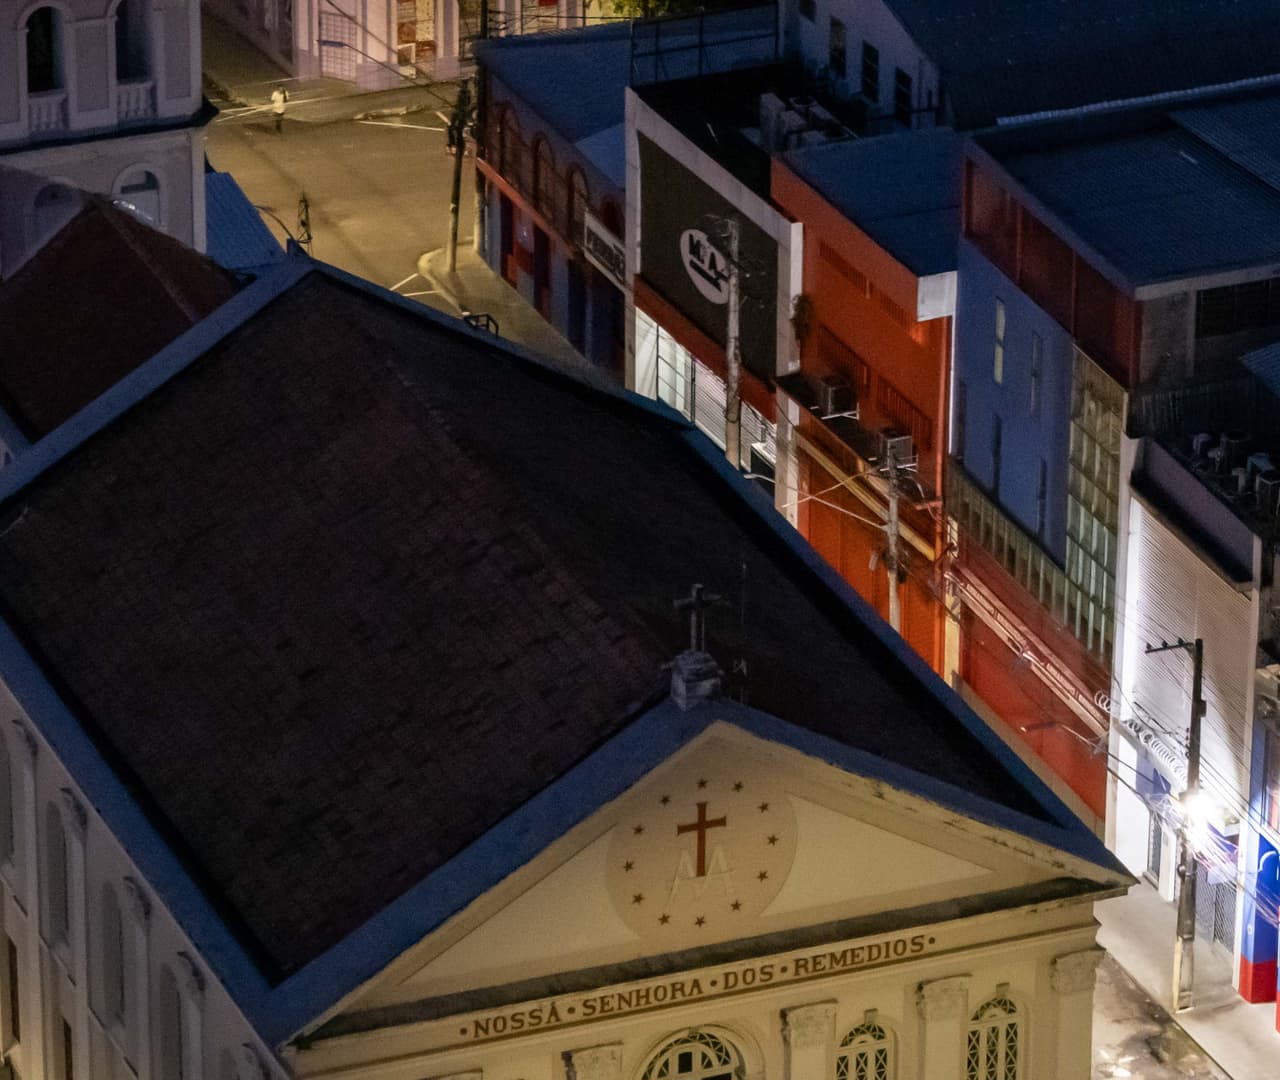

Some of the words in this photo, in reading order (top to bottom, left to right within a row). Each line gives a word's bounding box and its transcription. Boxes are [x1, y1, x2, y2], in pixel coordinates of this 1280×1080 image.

[582, 978, 703, 1017] SENHORA
[722, 964, 775, 990] DOS
[793, 934, 926, 976] REMEDIOS
